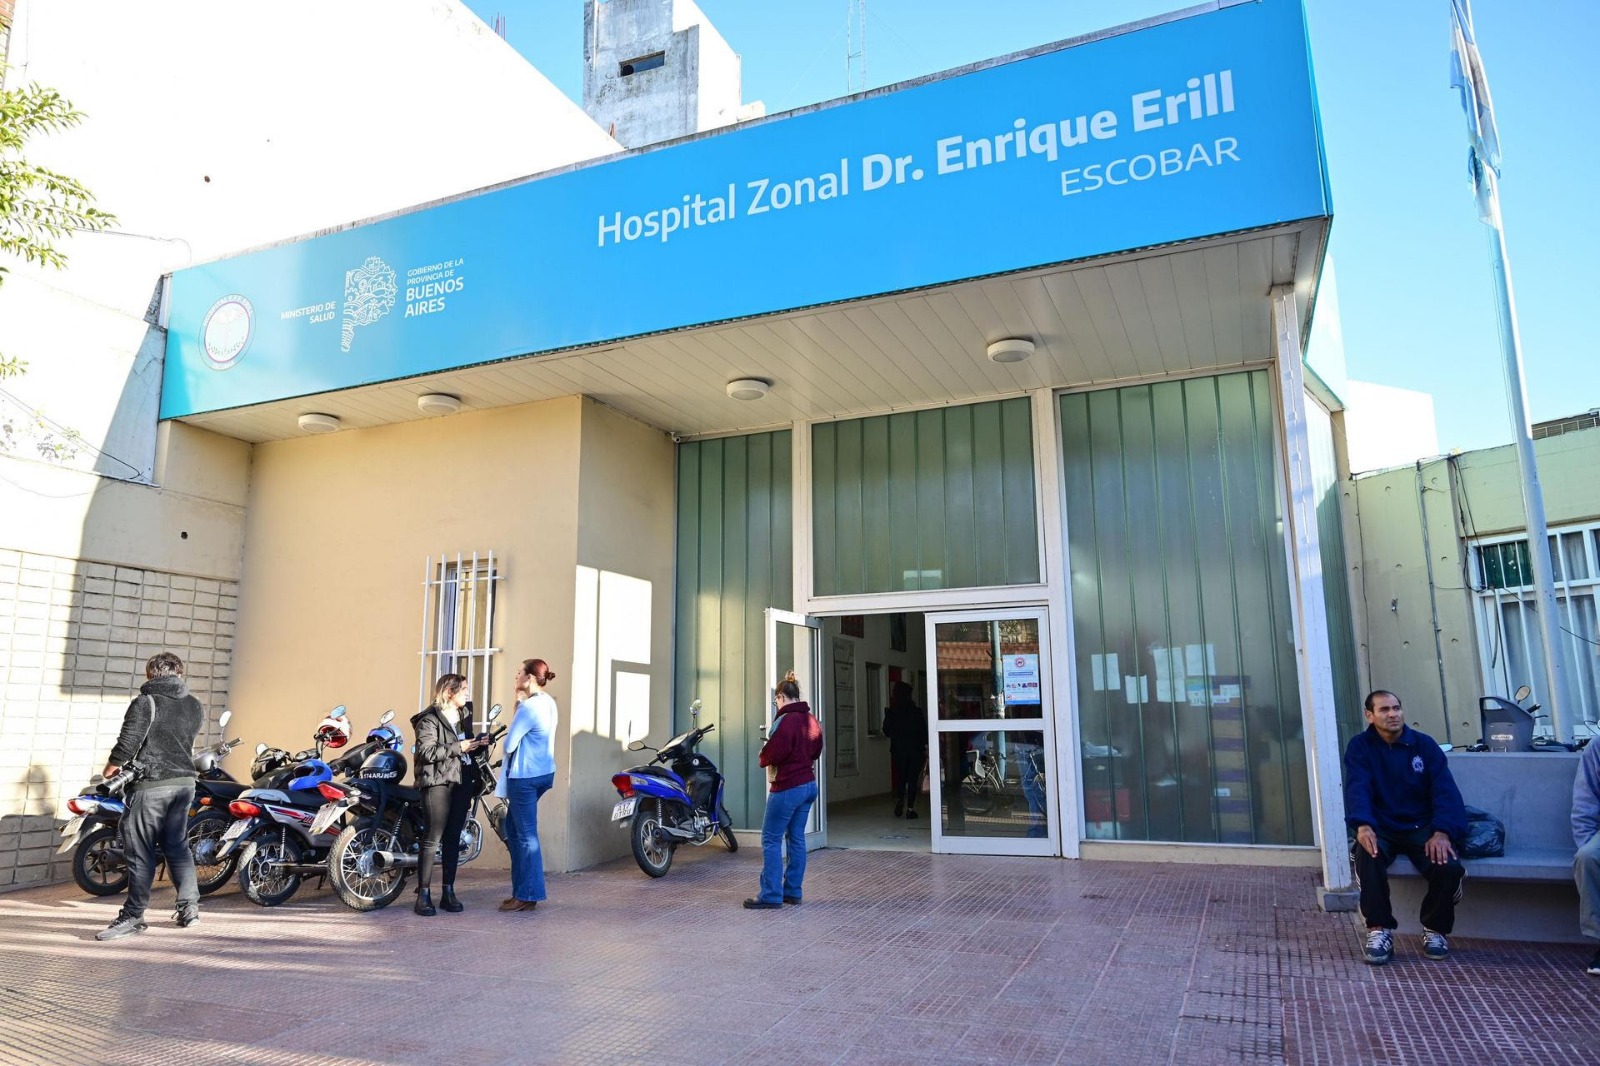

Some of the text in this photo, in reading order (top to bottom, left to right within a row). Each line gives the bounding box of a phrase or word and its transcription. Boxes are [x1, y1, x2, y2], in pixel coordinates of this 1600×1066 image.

[597, 69, 1235, 247] Hospital Zonal Dr. Enrique Erill
[1060, 136, 1241, 197] ESCOBAR
[406, 269, 455, 286] PROVINCIA DE
[407, 257, 464, 277] GOBIERNO DE LA
[405, 276, 464, 302] BUENOS
[280, 300, 337, 320] MINISTERIO DE
[309, 311, 336, 324] SALUD
[404, 296, 446, 318] AIRES
